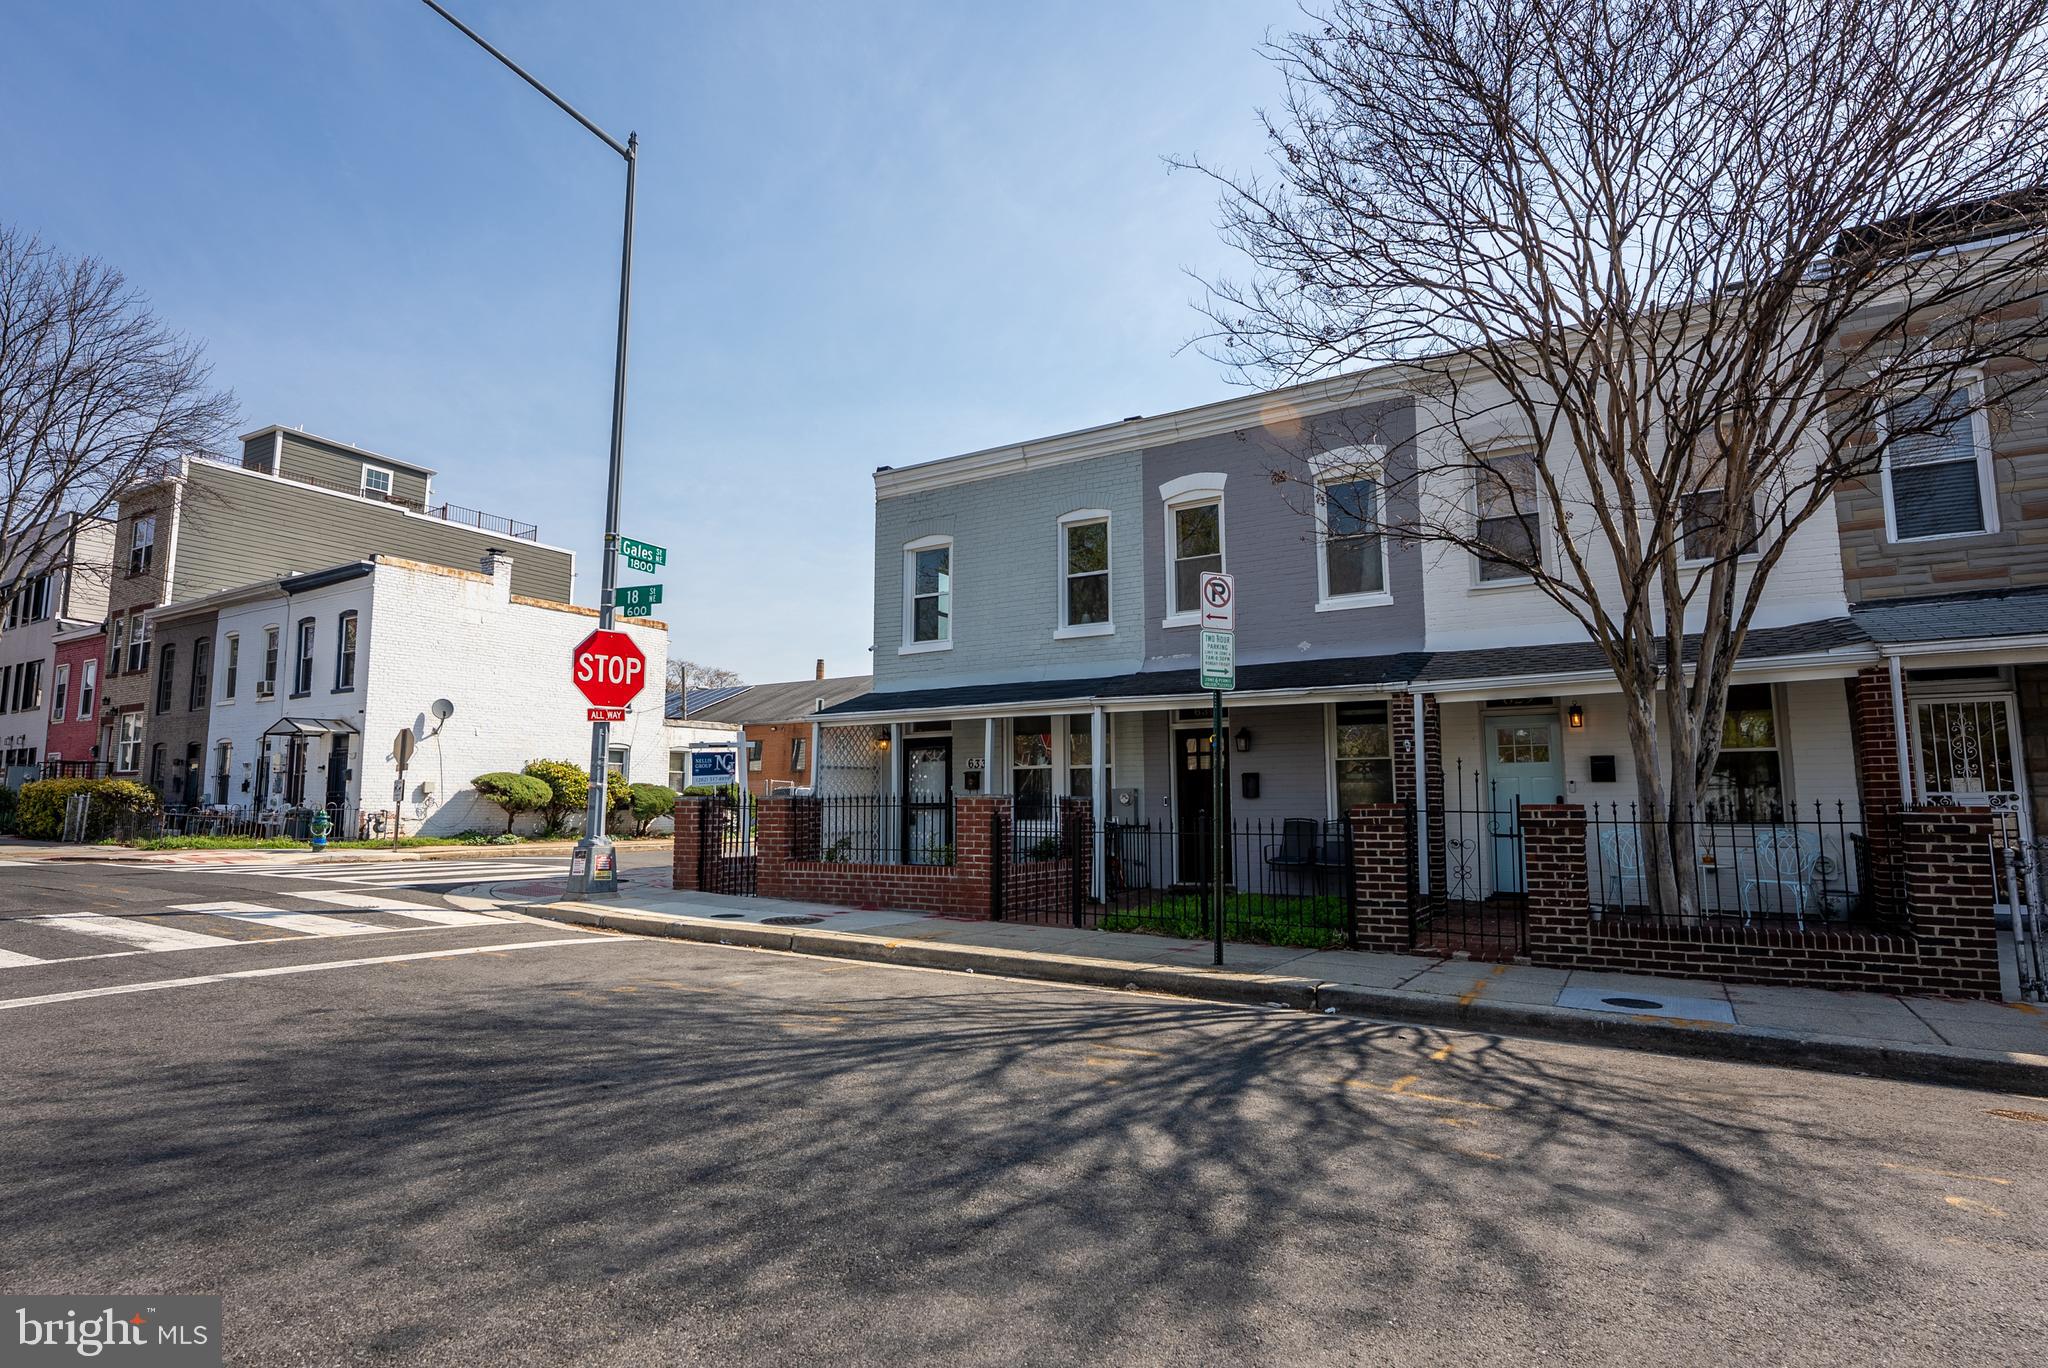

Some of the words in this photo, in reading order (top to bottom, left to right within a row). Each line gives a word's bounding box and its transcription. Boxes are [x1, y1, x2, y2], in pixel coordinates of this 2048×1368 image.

[623, 541, 653, 561] Gales
[656, 548, 662, 556] St
[631, 559, 653, 572] 1800
[655, 556, 662, 564] NE
[627, 590, 639, 604] 18
[650, 587, 656, 595] St
[627, 606, 647, 616] 600
[1205, 634, 1215, 643] TWO
[1216, 635, 1230, 644] HOUR
[577, 652, 641, 685] STOP
[591, 711, 604, 719] ALL
[607, 711, 621, 719] WAY
[714, 753, 735, 771] NG
